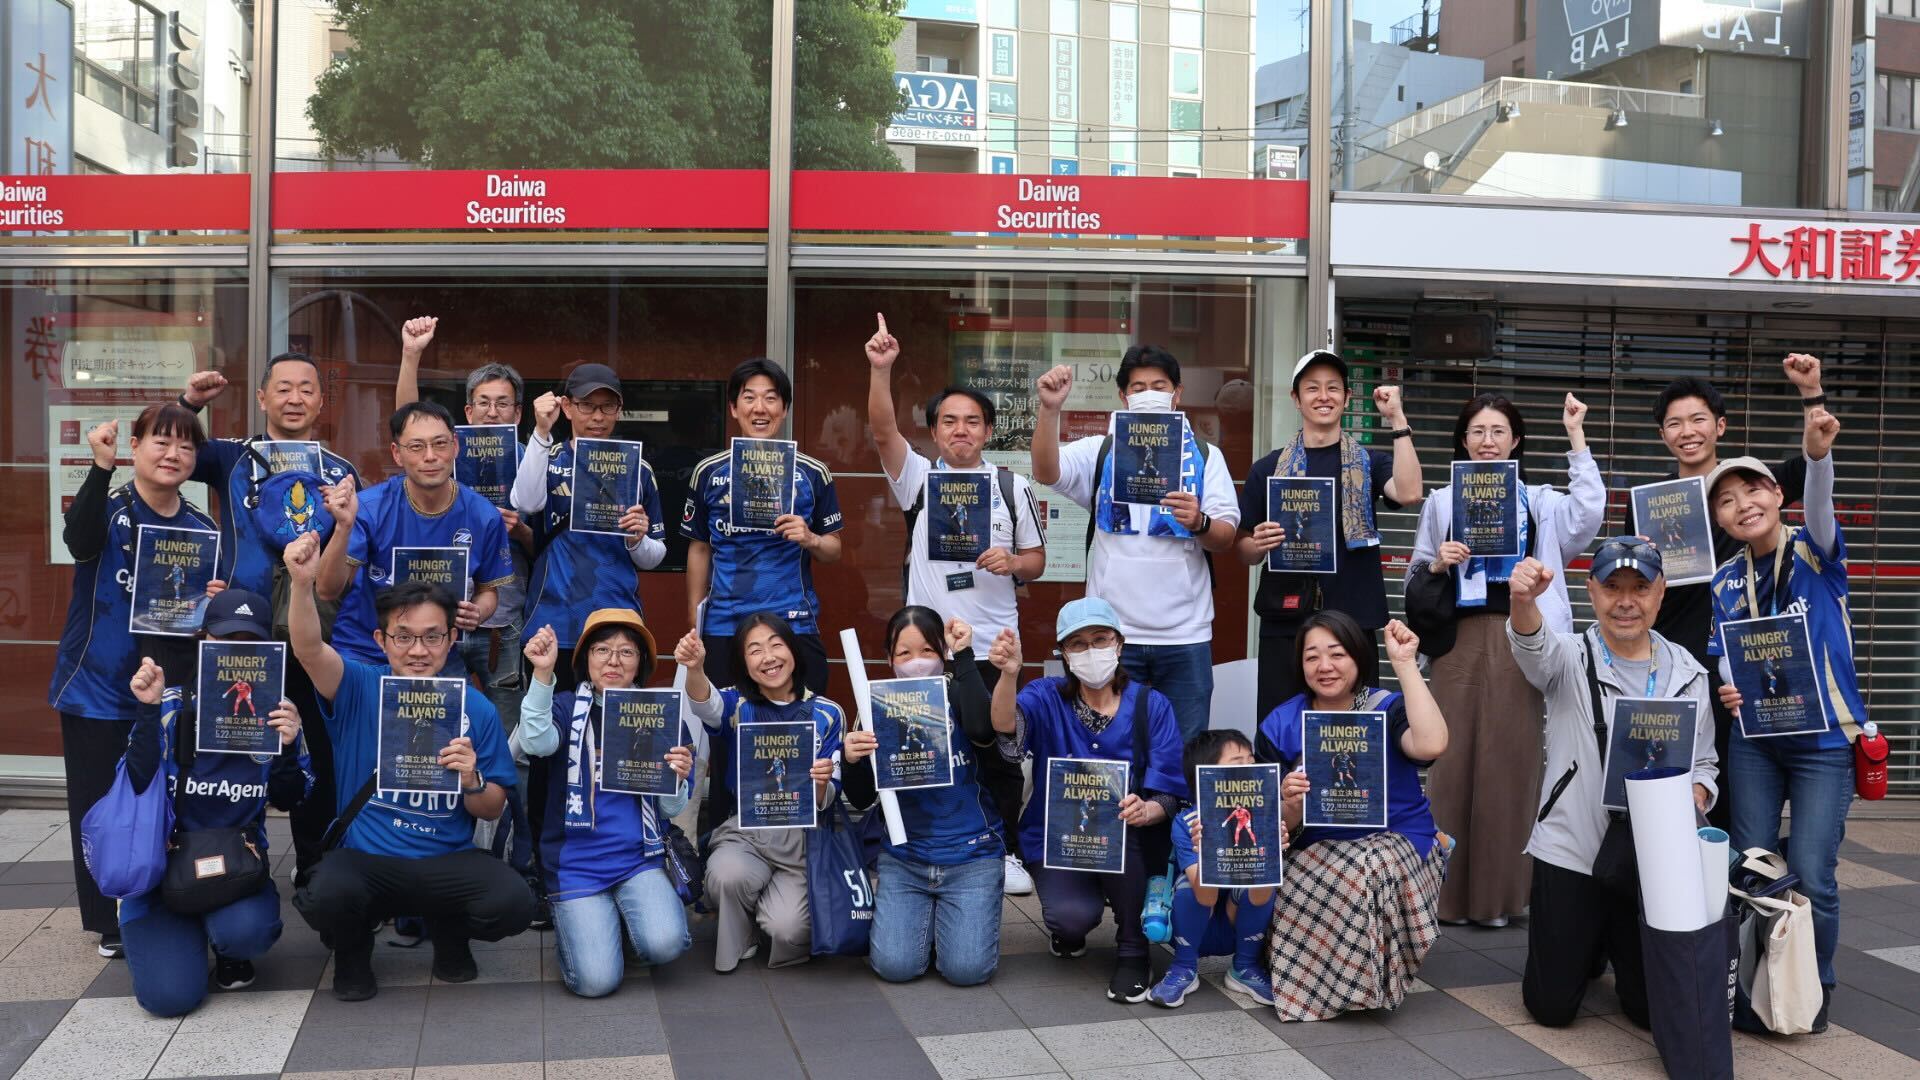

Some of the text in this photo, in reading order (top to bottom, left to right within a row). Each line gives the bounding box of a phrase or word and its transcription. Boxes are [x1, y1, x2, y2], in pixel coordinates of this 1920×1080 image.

[487, 174, 547, 197] Daiwa
[1018, 178, 1080, 202] Daiwa
[0, 204, 64, 225] curities
[467, 201, 566, 224] Securities
[997, 205, 1101, 230] Securities
[1128, 424, 1168, 433] HUNGRY
[466, 437, 503, 446] HUNGRY
[1128, 436, 1168, 446] ALWAYS
[268, 451, 307, 462] HUNGRY
[467, 448, 504, 457] ALWAYS
[588, 451, 627, 462] HUNGRY
[742, 450, 784, 462] HUNGRY
[588, 462, 627, 473] ALWAYS
[742, 463, 784, 475] ALWAYS
[1462, 473, 1505, 484] HUNGRY
[940, 483, 978, 492] HUNGRY
[1462, 488, 1506, 498] ALWAYS
[940, 495, 978, 505] ALWAYS
[1281, 489, 1320, 499] HUNGRY
[1648, 492, 1688, 507] HUNGRY
[1281, 502, 1320, 511] ALWAYS
[1650, 504, 1690, 520] ALWAYS
[155, 540, 202, 554] HUNGRY
[153, 554, 200, 567] ALWAYS
[408, 560, 452, 570] HUNGRY
[408, 573, 452, 582] ALWAYS
[1740, 631, 1789, 647] HUNGRY
[1744, 646, 1793, 662] ALWAYS
[217, 656, 267, 668] HUNGRY
[217, 670, 267, 682] ALWAYS
[397, 692, 446, 704] HUNGRY
[885, 691, 929, 704] HUNGRY
[397, 707, 446, 719] ALWAYS
[619, 703, 665, 714] HUNGRY
[887, 704, 931, 718] ALWAYS
[619, 716, 664, 728] ALWAYS
[1631, 713, 1680, 726] HUNGRY
[1320, 726, 1368, 738] HUNGRY
[1628, 728, 1679, 741] ALWAYS
[754, 735, 799, 746] HUNGRY
[1320, 741, 1368, 753] ALWAYS
[754, 748, 799, 759] ALWAYS
[1064, 773, 1110, 785] HUNGRY
[1215, 780, 1263, 792] HUNGRY
[1064, 787, 1110, 801] ALWAYS
[1215, 795, 1264, 808] ALWAYS
